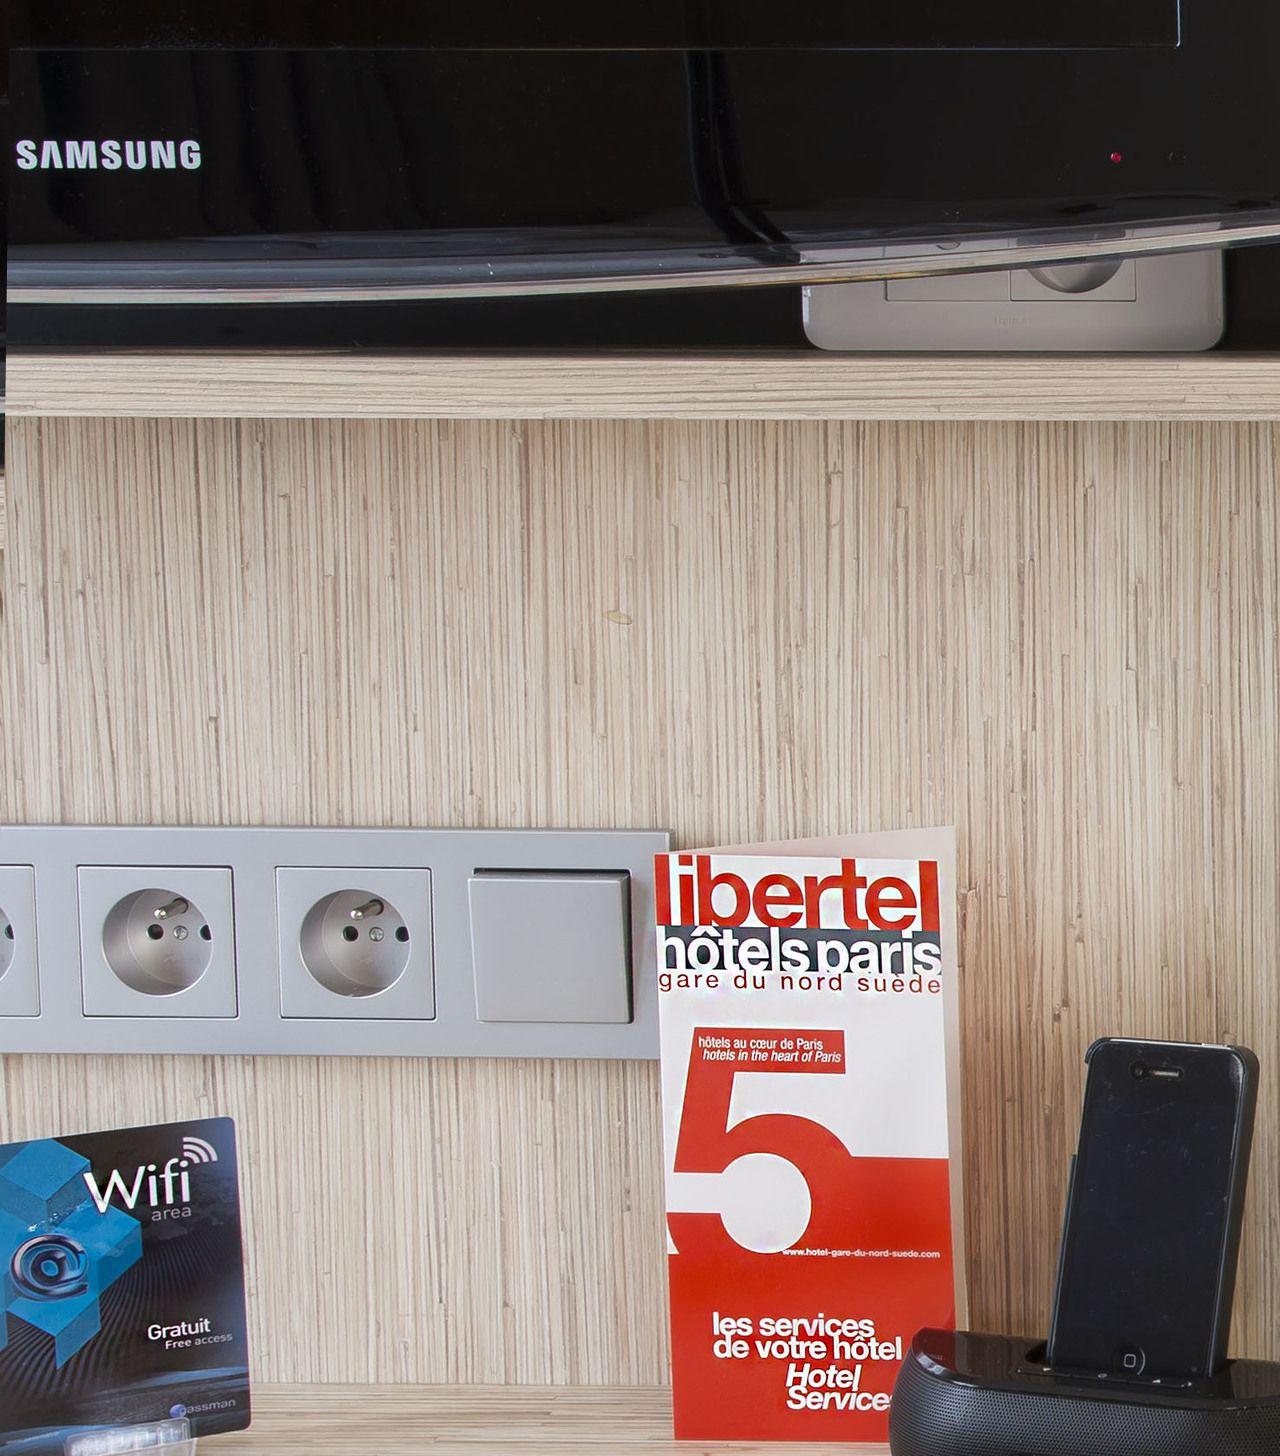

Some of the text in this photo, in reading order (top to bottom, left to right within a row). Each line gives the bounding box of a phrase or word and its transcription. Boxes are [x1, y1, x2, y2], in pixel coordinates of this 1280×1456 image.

[16, 140, 201, 169] SAMSUNG
[654, 854, 941, 931] libertel
[656, 925, 942, 975] hôtels paris
[658, 970, 941, 994] gare du nord suède
[698, 1036, 823, 1050] hôtels au cœur de Paris
[702, 1049, 842, 1063] hotels in the heart of Paris
[83, 1157, 191, 1214] Wifi
[151, 1206, 192, 1222] area
[781, 1247, 941, 1259] www.hotel-gare-du-nord-suede.com
[148, 1318, 211, 1341] Gratuit
[712, 1312, 875, 1338] les services
[165, 1333, 233, 1350] Free access
[713, 1333, 902, 1361] de votre hôtel
[785, 1363, 862, 1389] Hotel
[786, 1386, 893, 1411] Service
